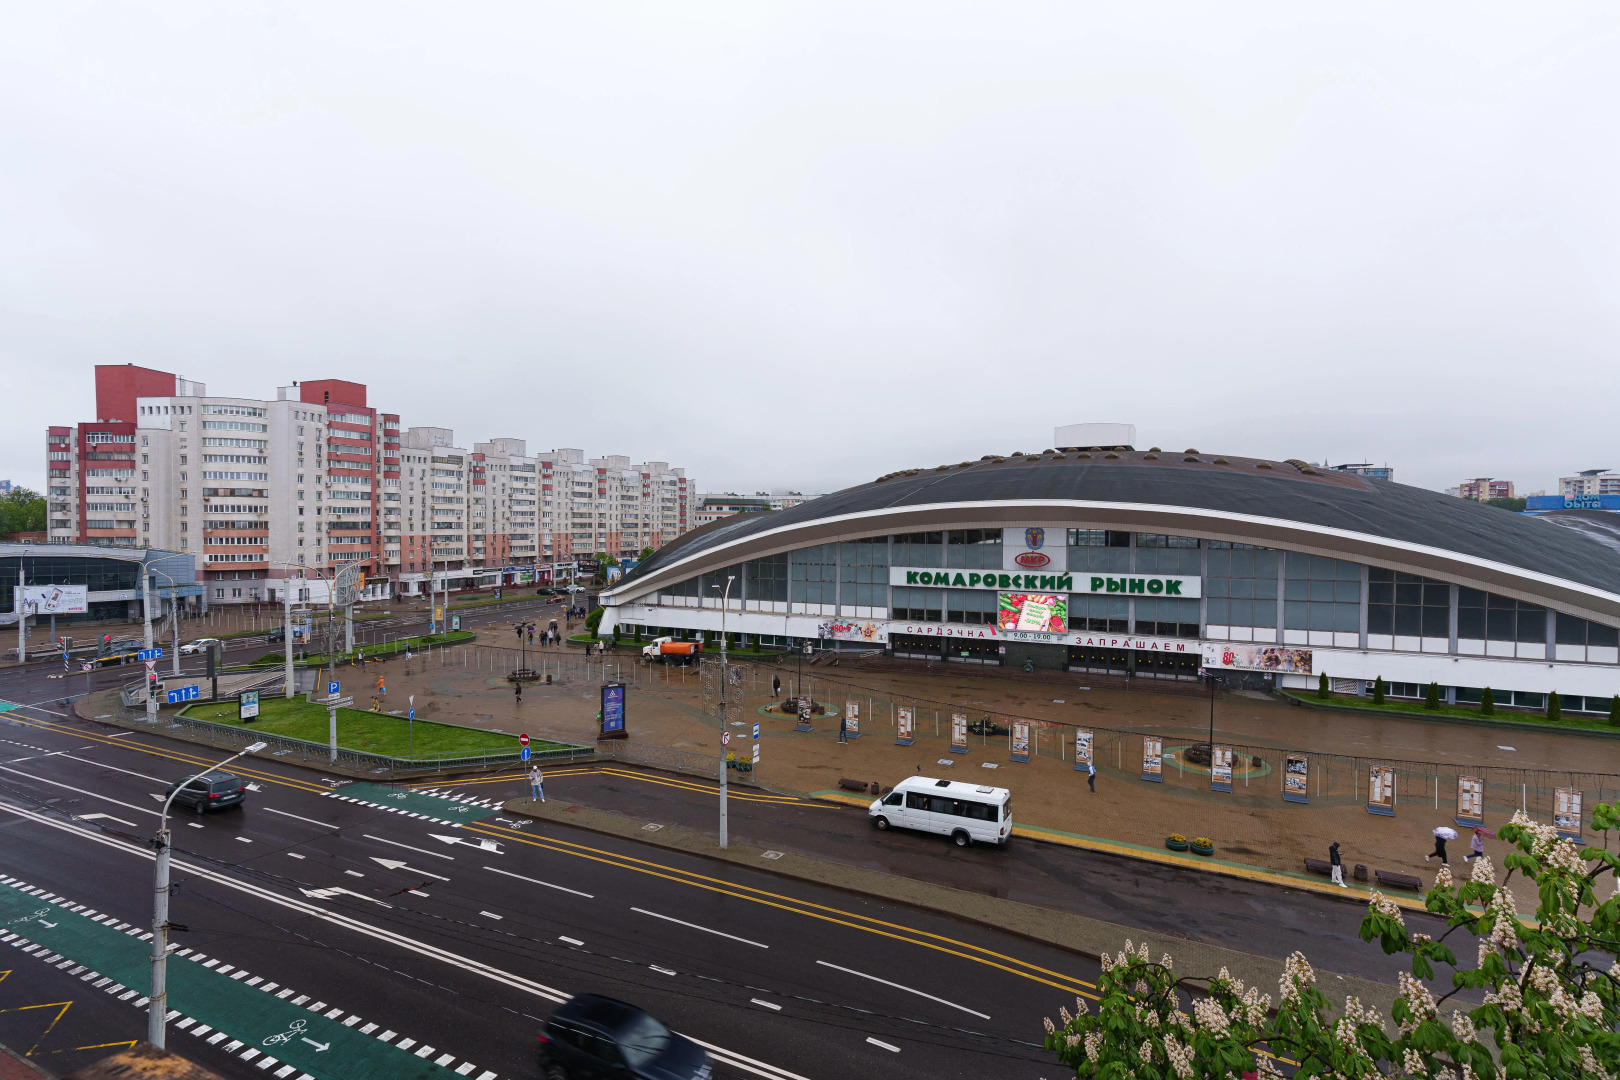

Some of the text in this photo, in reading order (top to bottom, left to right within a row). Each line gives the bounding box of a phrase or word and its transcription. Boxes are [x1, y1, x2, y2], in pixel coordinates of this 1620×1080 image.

[906, 571, 1183, 595] КОМАРОВСКИЙ РЫНОК
[906, 625, 985, 638] САРДЭЧНА
[1075, 637, 1185, 652] ЗАПРАШАЕМ
[1222, 651, 1234, 663] 80
